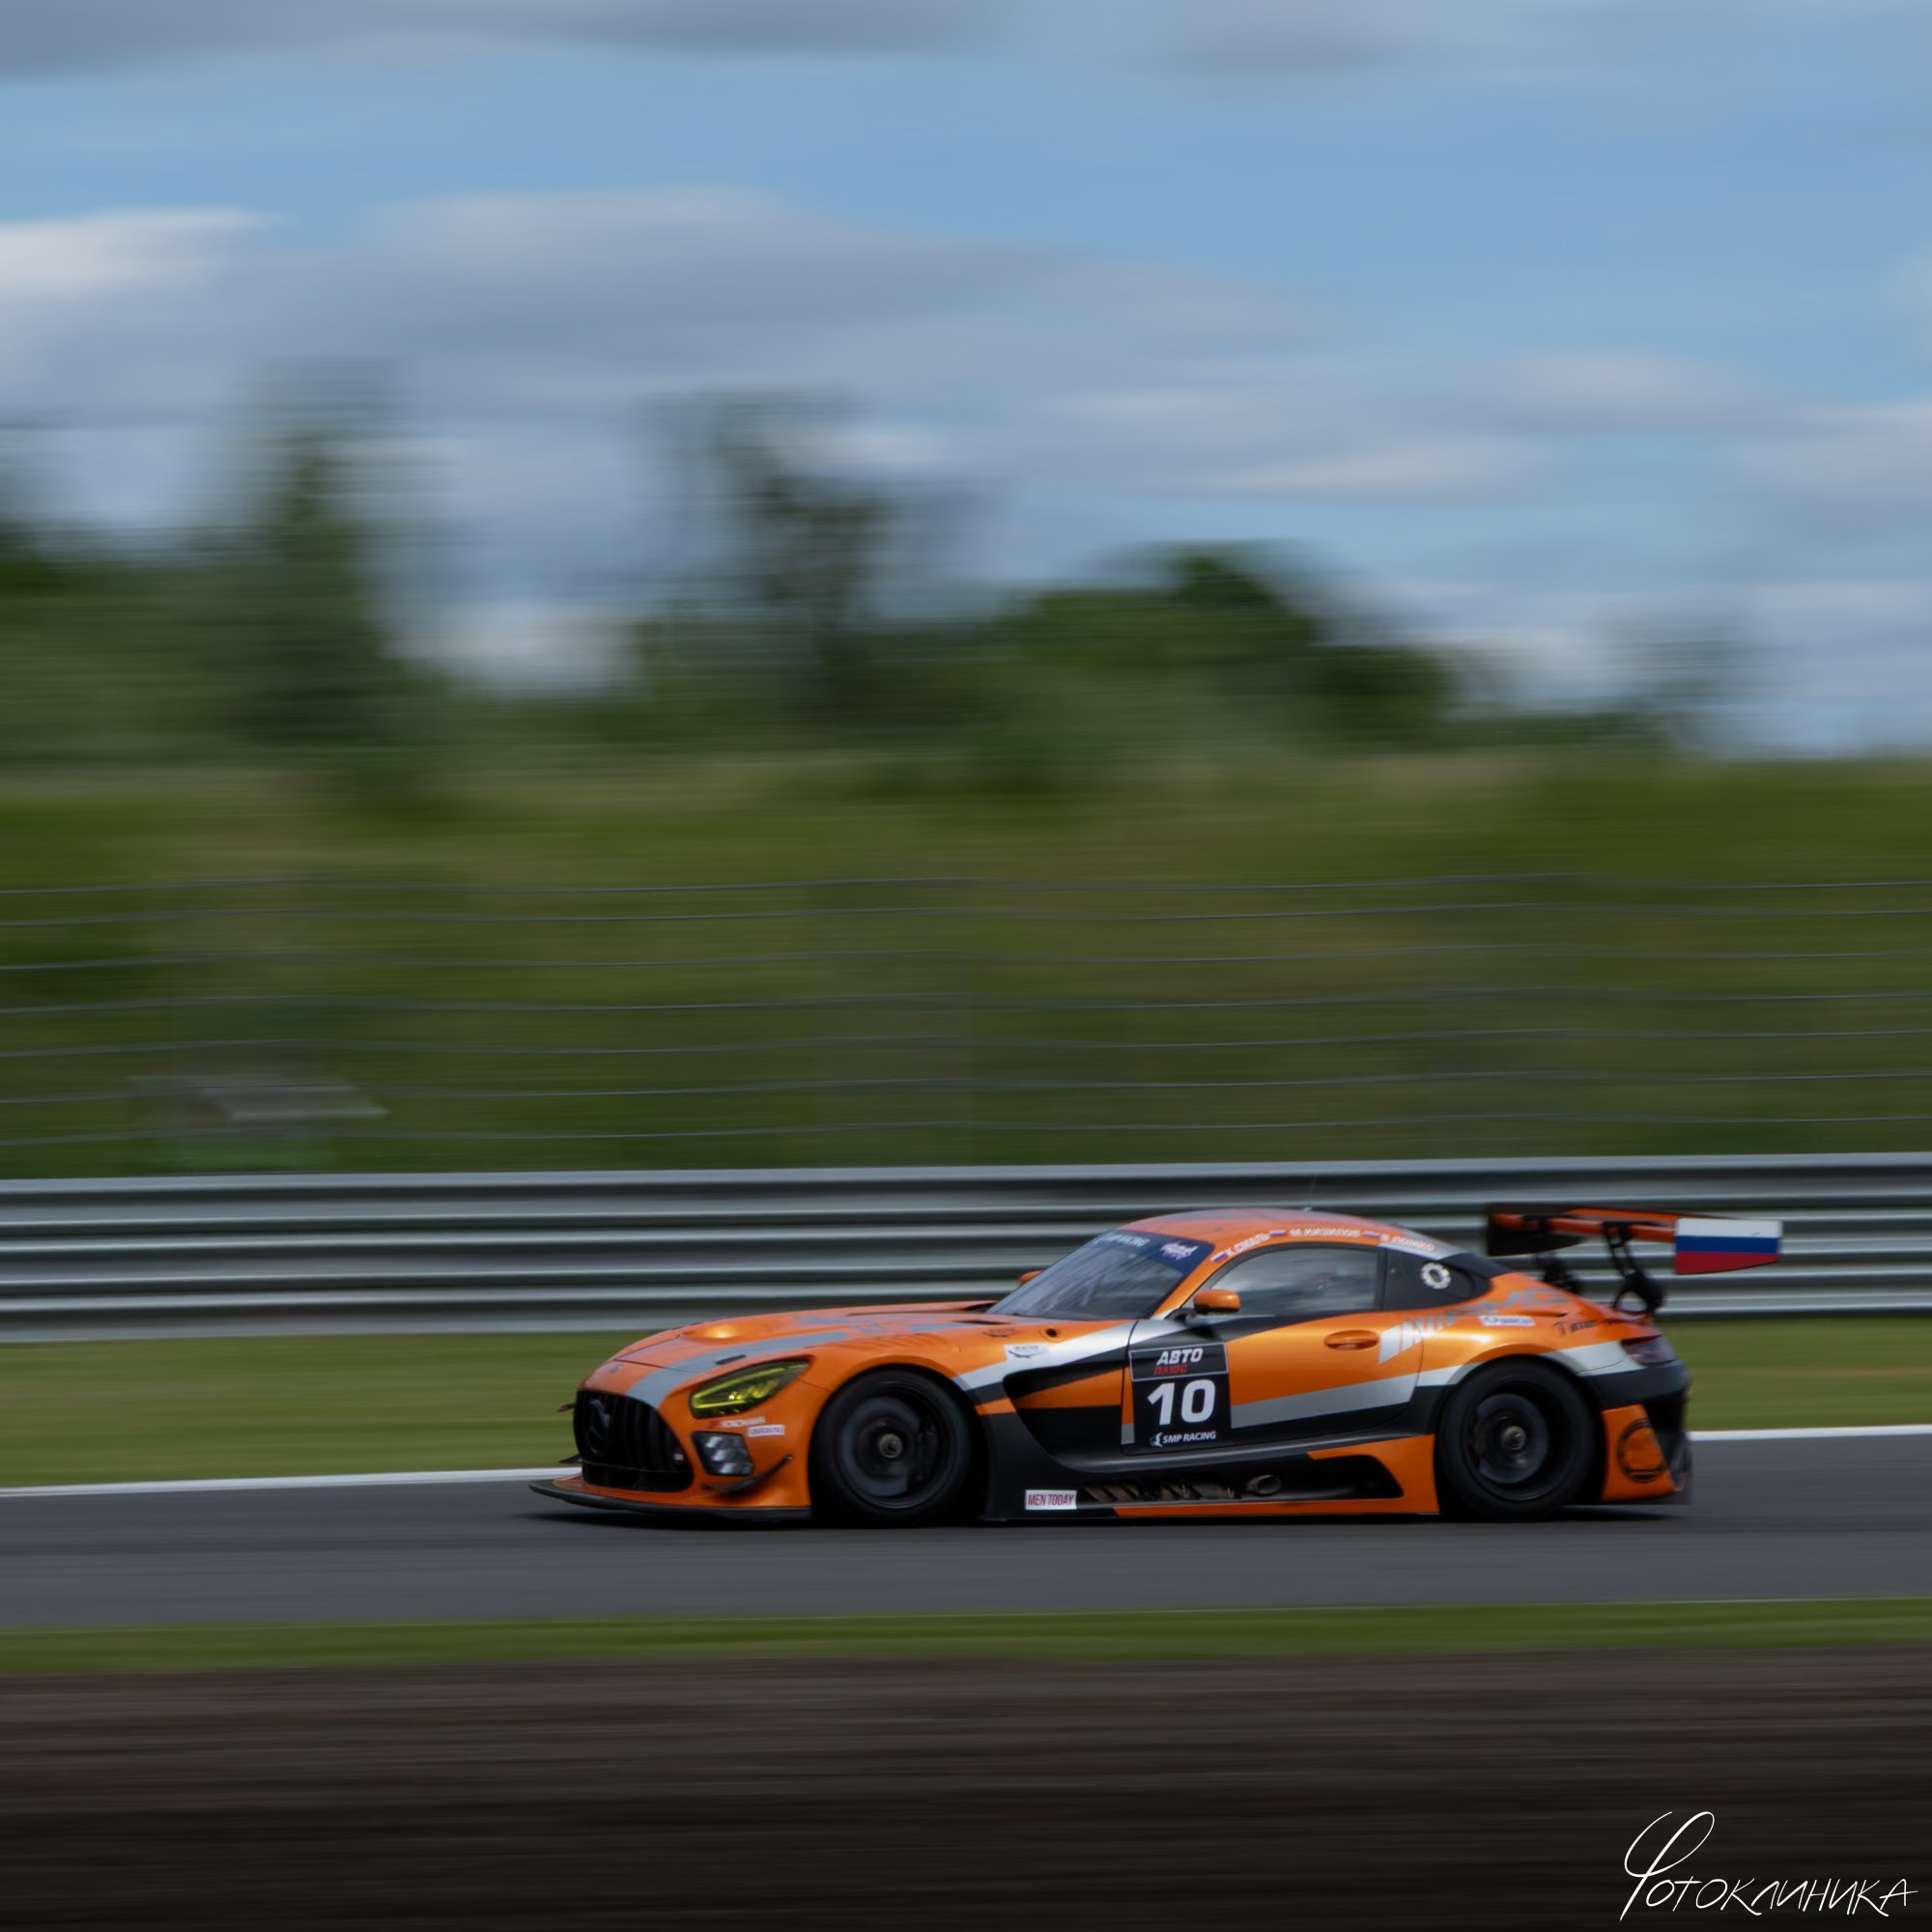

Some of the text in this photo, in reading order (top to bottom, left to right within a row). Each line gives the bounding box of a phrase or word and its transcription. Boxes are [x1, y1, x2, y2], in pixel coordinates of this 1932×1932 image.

[1156, 1348, 1203, 1366] АВТО
[1147, 1379, 1216, 1426] 10
[1162, 1431, 1216, 1444] SMP RACING
[1028, 1493, 1074, 1506] MEN TODAY
